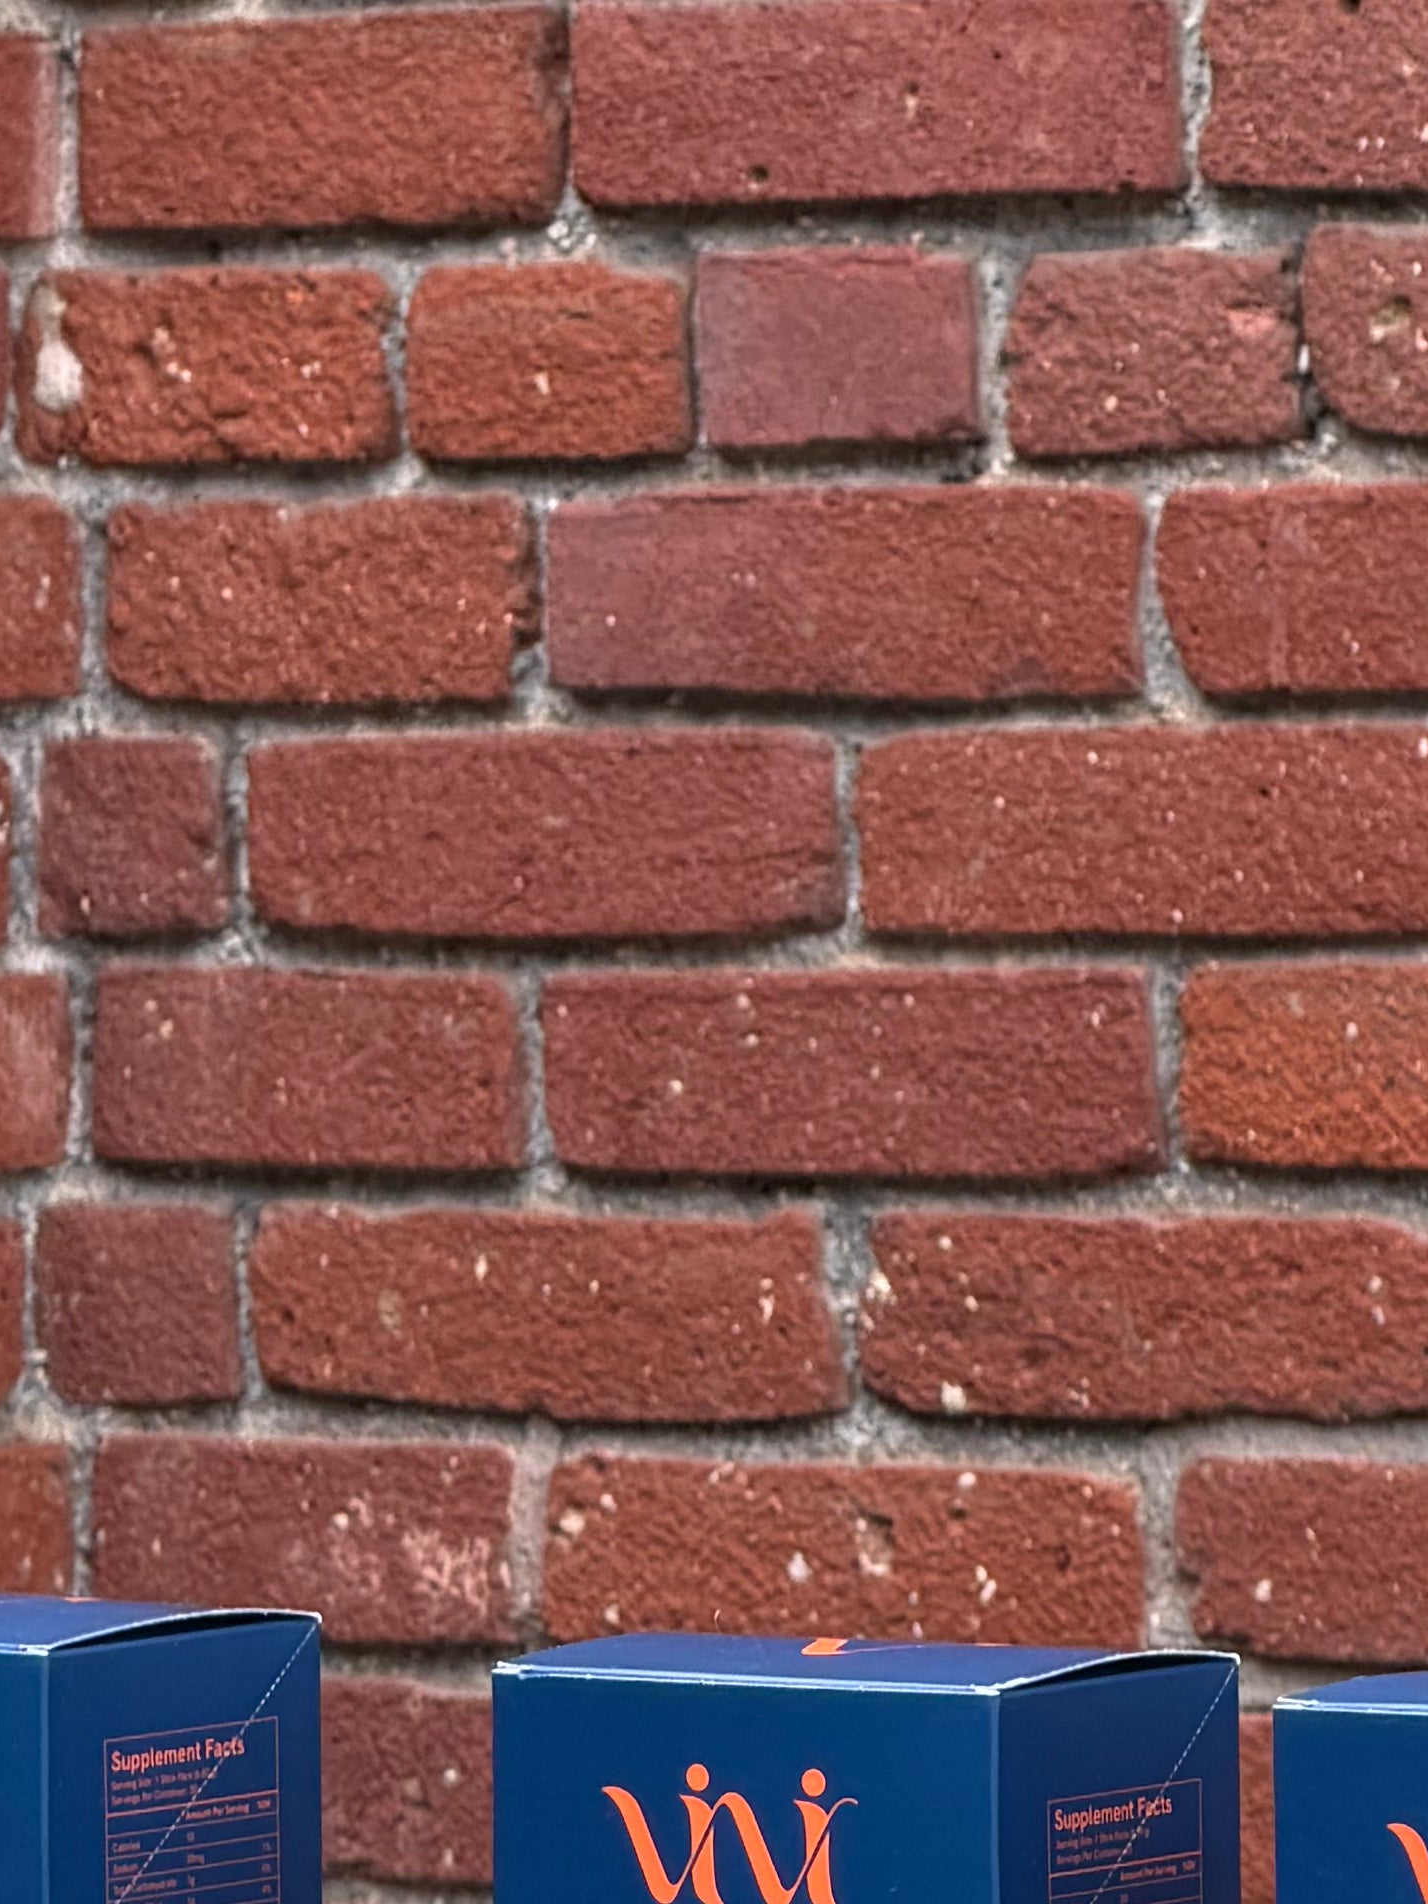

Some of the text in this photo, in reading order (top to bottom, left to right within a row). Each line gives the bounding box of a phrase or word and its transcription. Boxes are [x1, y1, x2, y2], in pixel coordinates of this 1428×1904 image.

[111, 1736, 245, 1774] Supplement Facts
[1055, 1796, 1172, 1833] Supplement Facts
